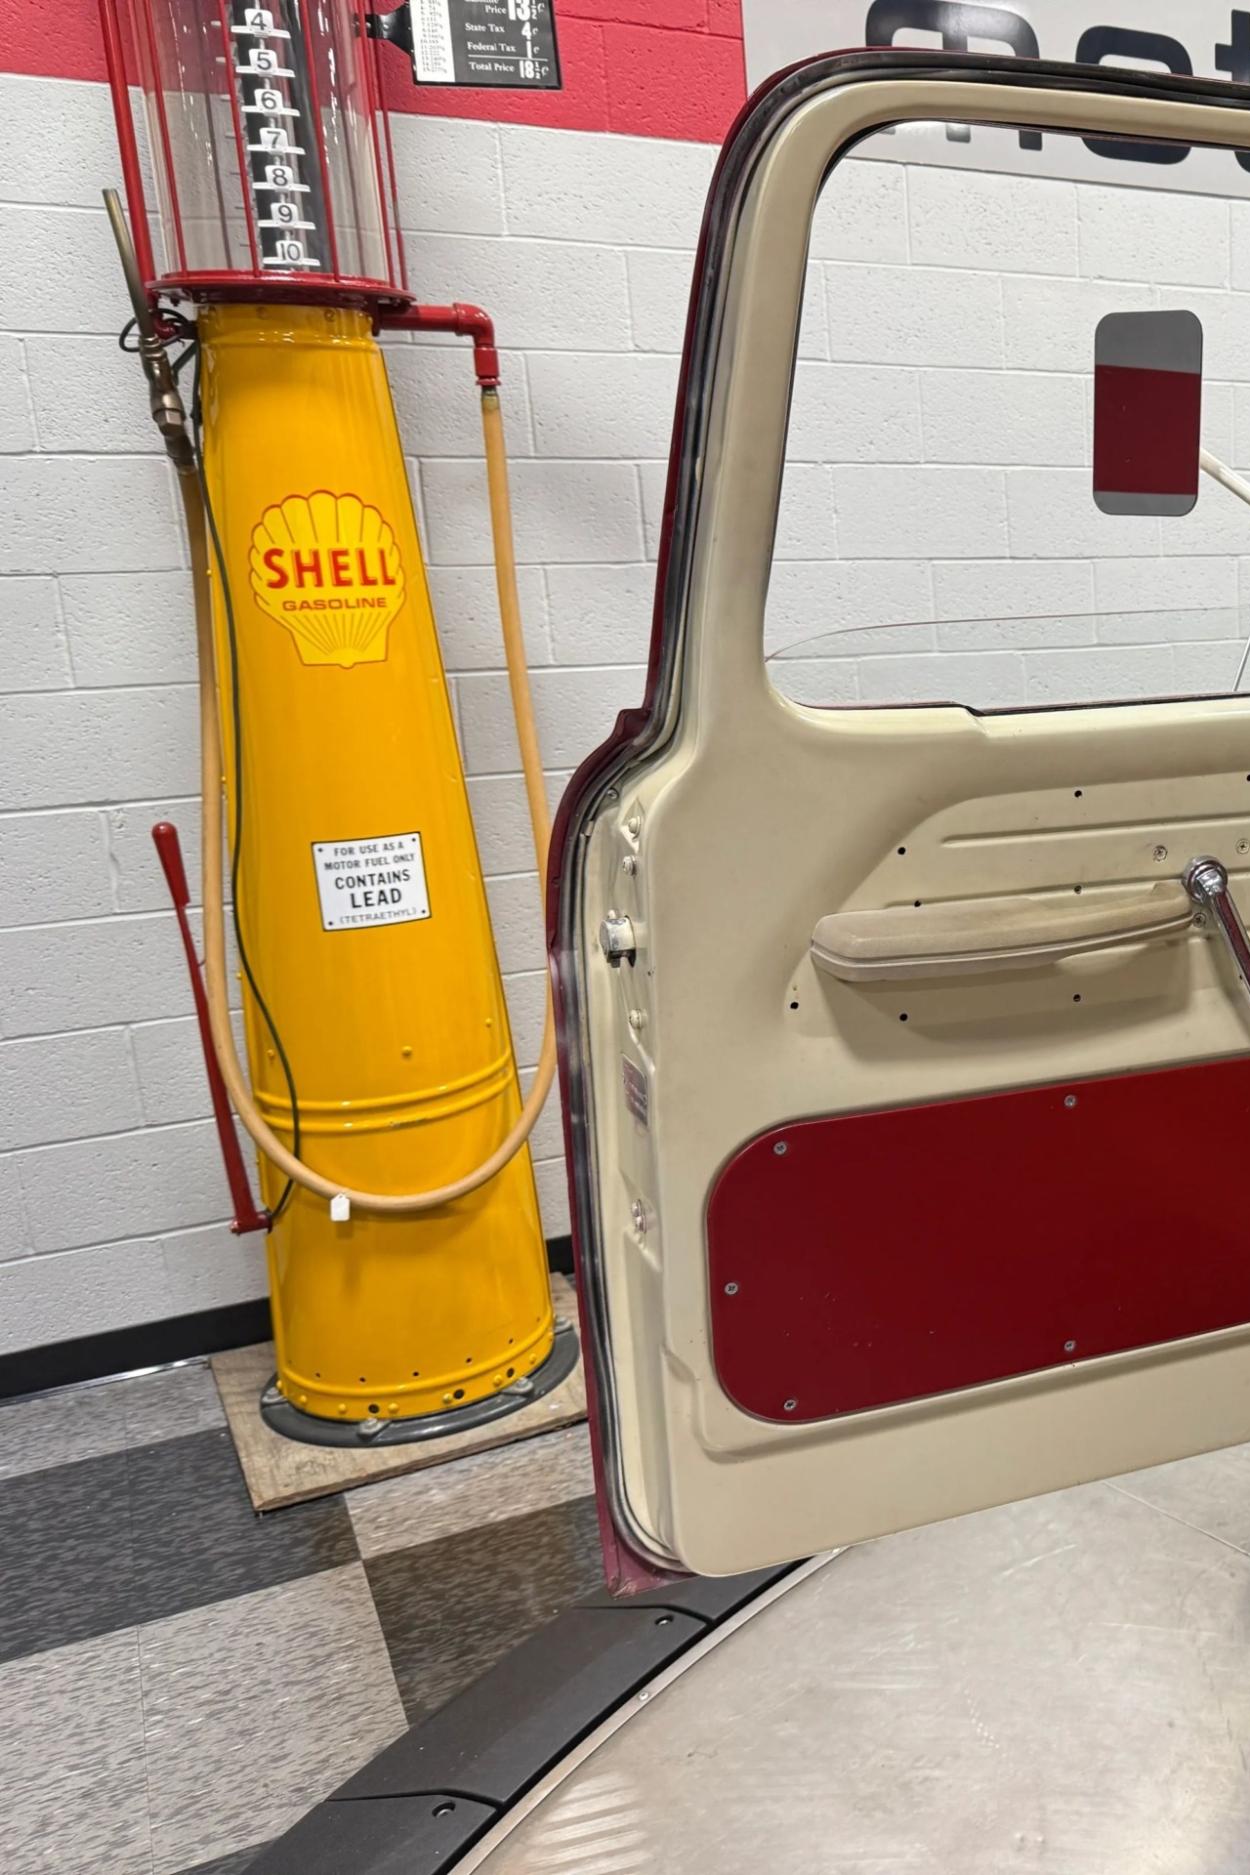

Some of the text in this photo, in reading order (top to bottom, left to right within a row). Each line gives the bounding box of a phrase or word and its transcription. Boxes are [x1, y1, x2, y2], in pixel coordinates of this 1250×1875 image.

[251, 12, 267, 31] 4
[465, 22, 487, 32] State
[487, 24, 505, 33] Tax
[467, 41, 497, 51] Federal
[498, 43, 516, 52] Tax
[257, 51, 272, 70] 5
[469, 62, 492, 71] Total
[494, 63, 514, 72] Price
[261, 91, 277, 110] 6
[267, 131, 281, 149] 7
[272, 168, 288, 187] 8
[278, 205, 293, 223] 9
[281, 243, 301, 261] 10
[263, 548, 397, 589] SHELL
[282, 597, 387, 612] GASOLINE
[334, 841, 405, 857] FOR USE AS A
[324, 853, 415, 871] MOTOR FUEL ONLY
[335, 869, 411, 890] CONTAINS
[350, 888, 403, 909] LEAD
[340, 907, 417, 925] (TETRAETHYL)
